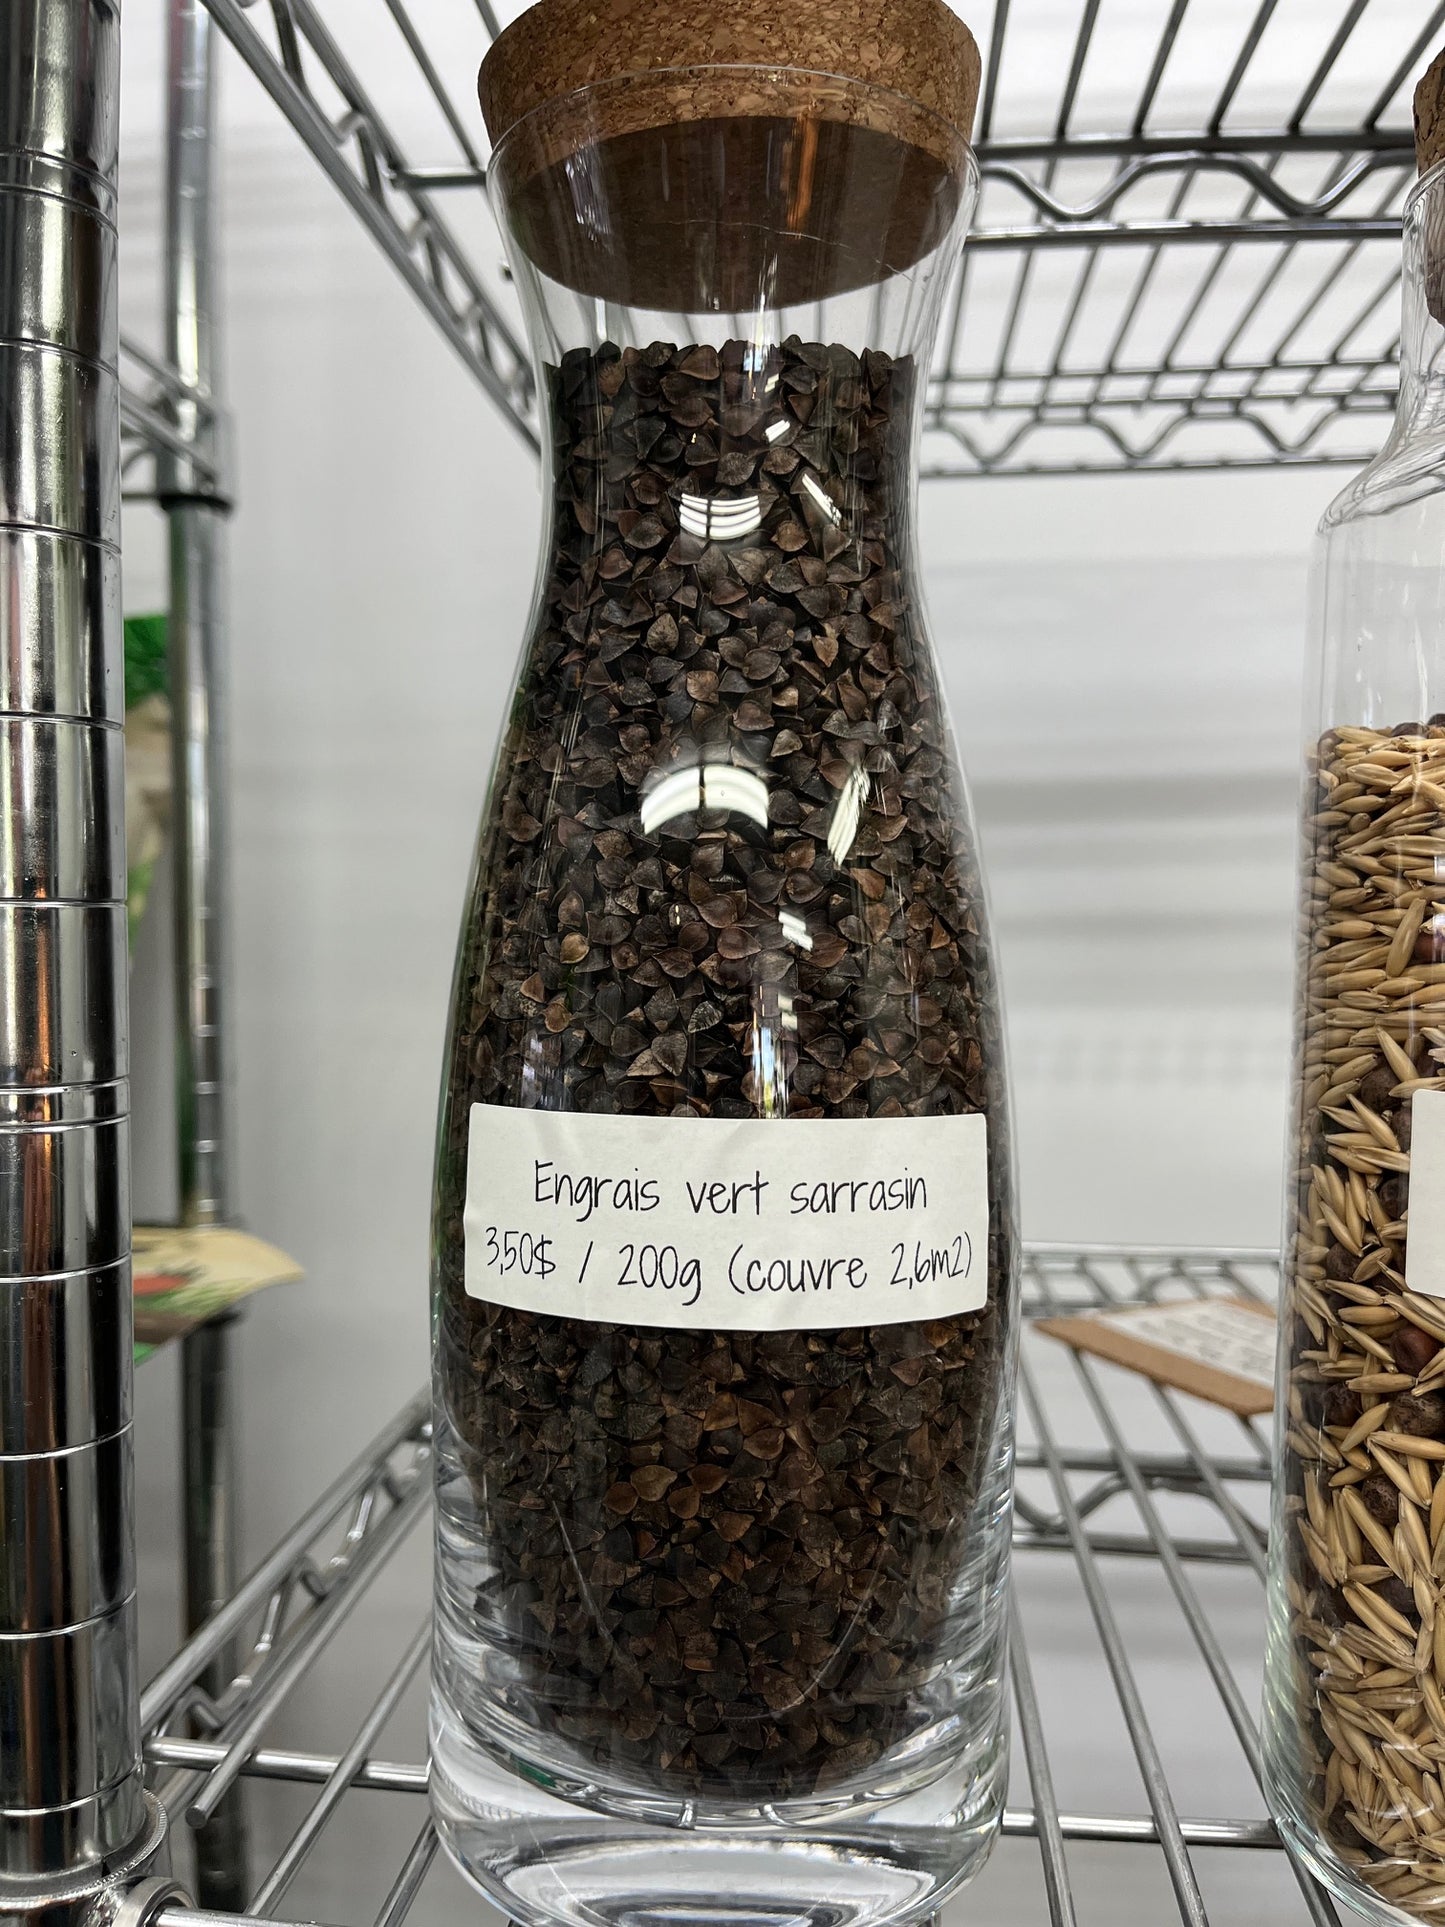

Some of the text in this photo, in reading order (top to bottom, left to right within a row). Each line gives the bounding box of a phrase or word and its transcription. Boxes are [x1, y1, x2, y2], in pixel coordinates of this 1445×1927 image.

[535, 1160, 926, 1222] Engrais vert sarrasin
[486, 1227, 971, 1312] 3,50$ / 200g (couvre 2,6m2)
